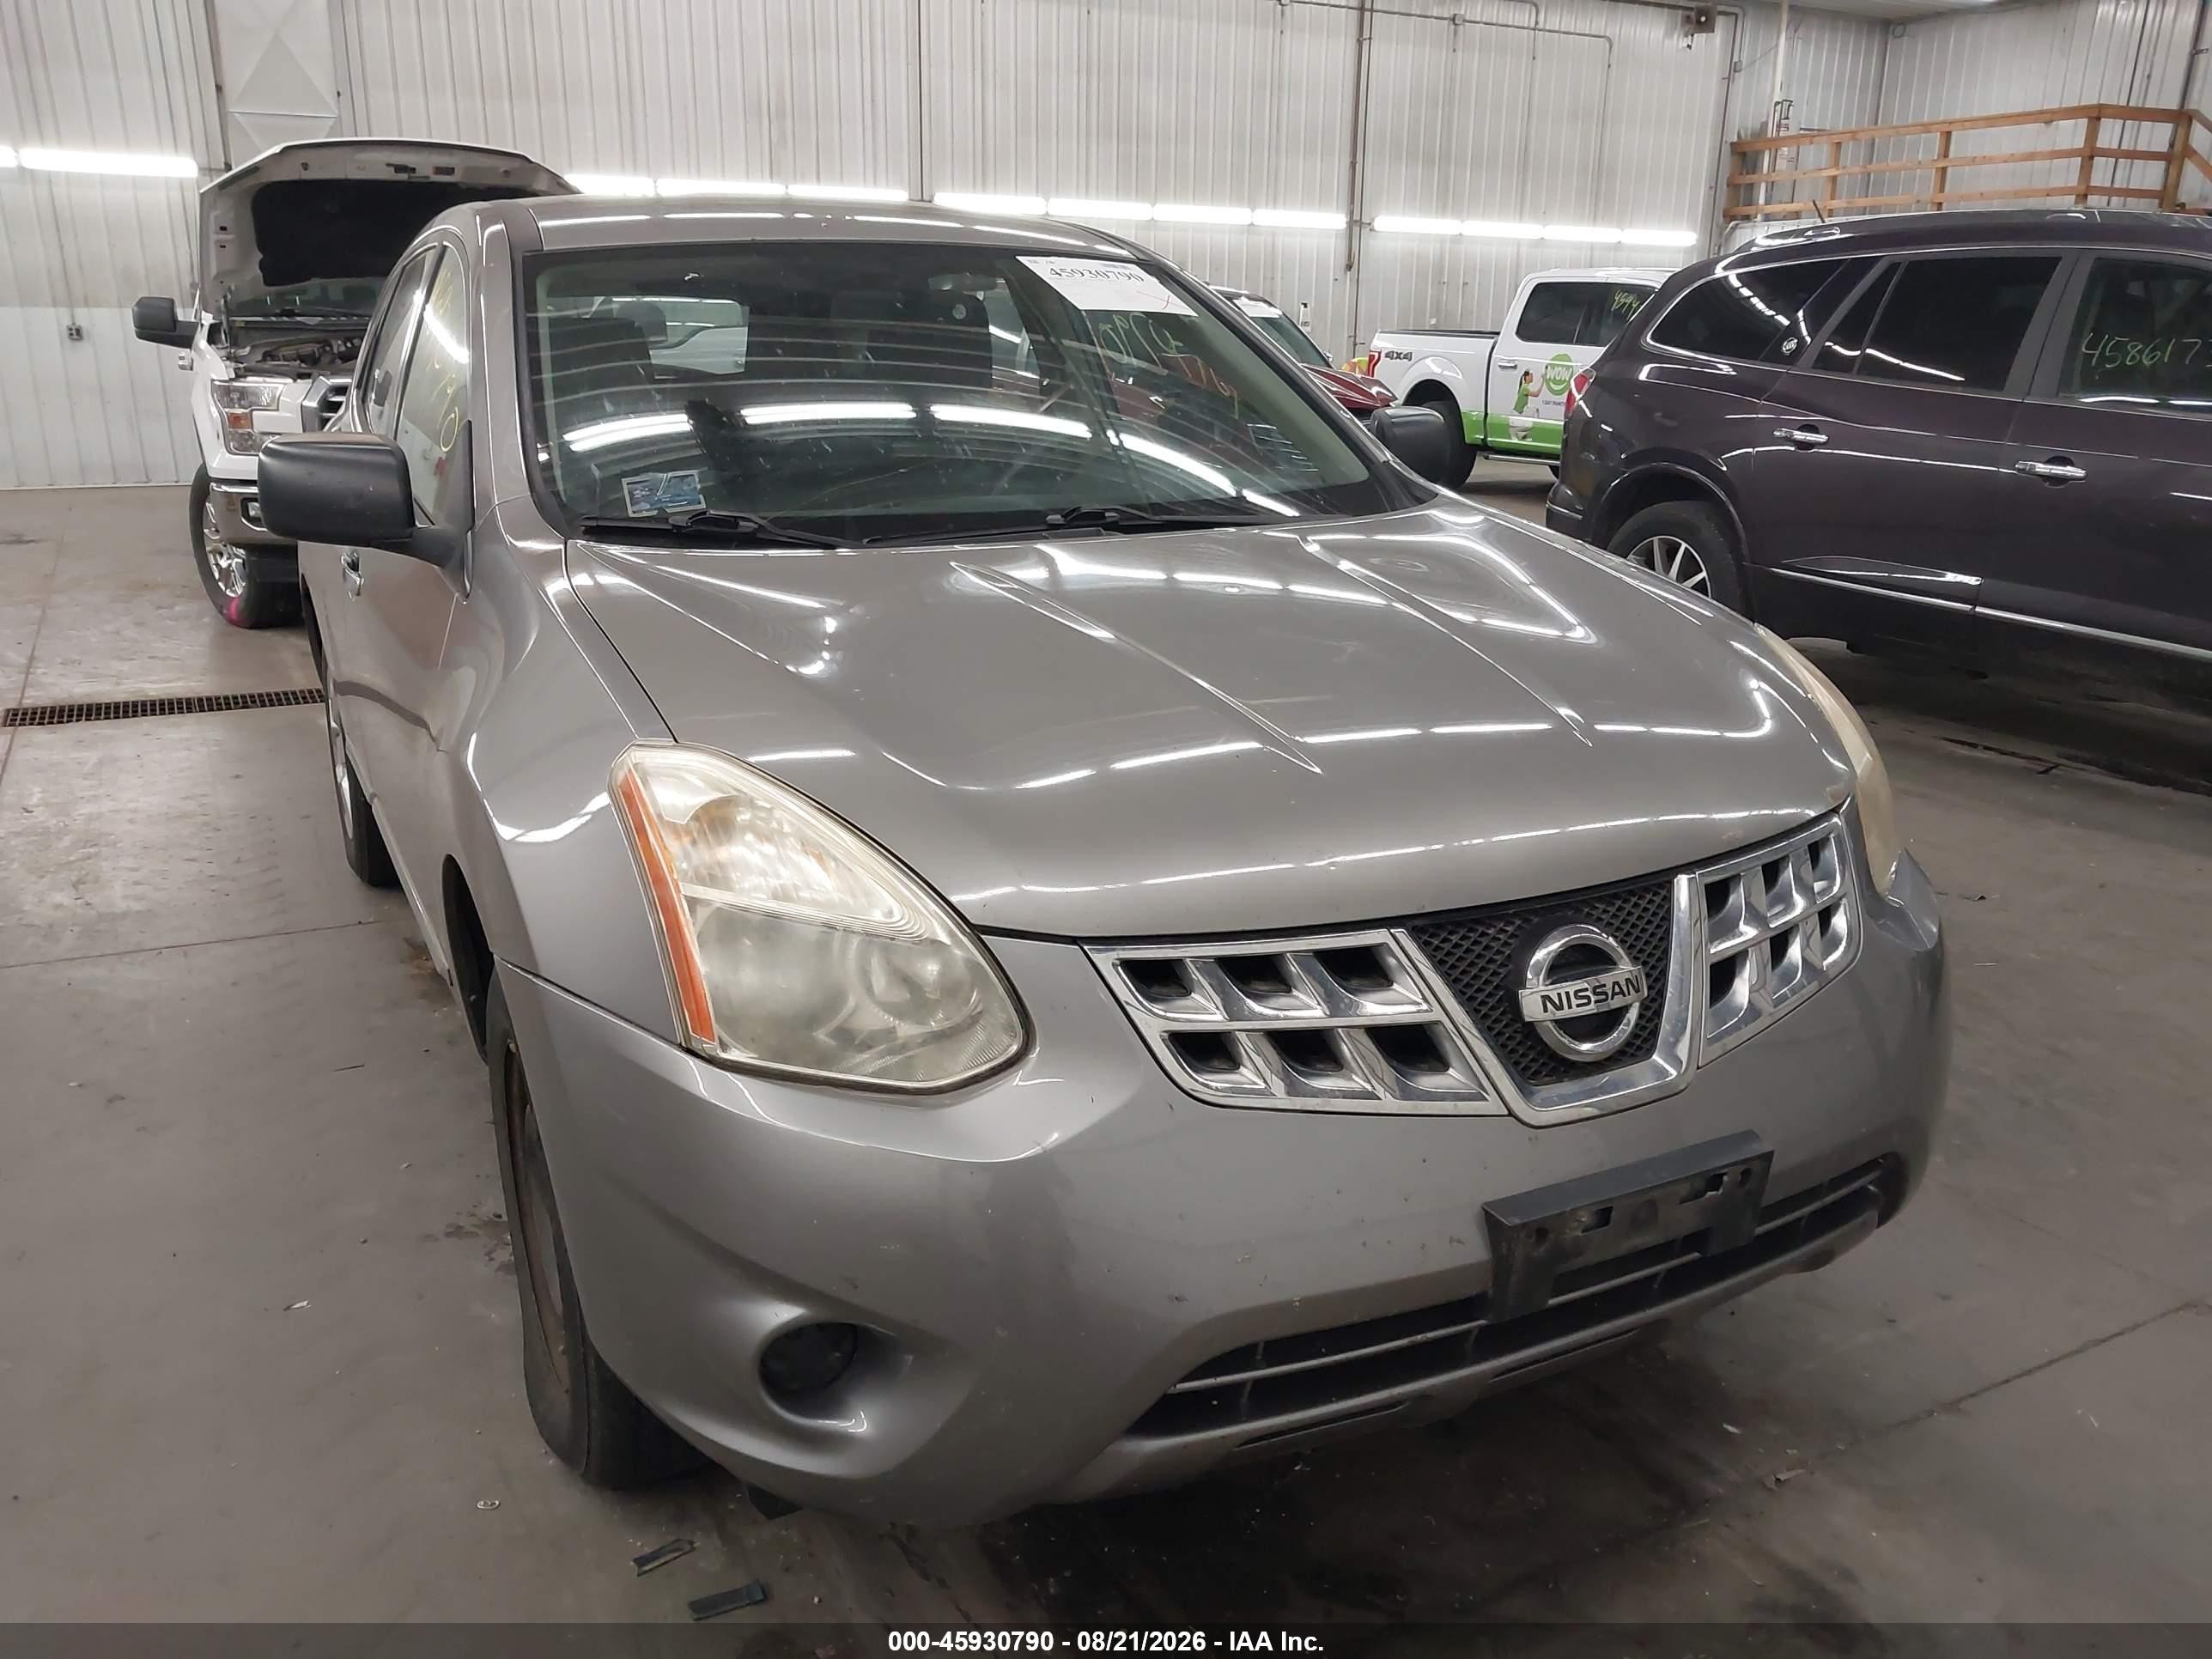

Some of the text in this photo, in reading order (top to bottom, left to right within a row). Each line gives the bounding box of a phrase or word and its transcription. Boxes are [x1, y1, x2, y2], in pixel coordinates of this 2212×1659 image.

[1049, 267, 1146, 283] 45930790
[1611, 289, 1642, 320] 4594
[1546, 364, 1573, 382] WOW
[1540, 975, 1641, 1013] NISSAN
